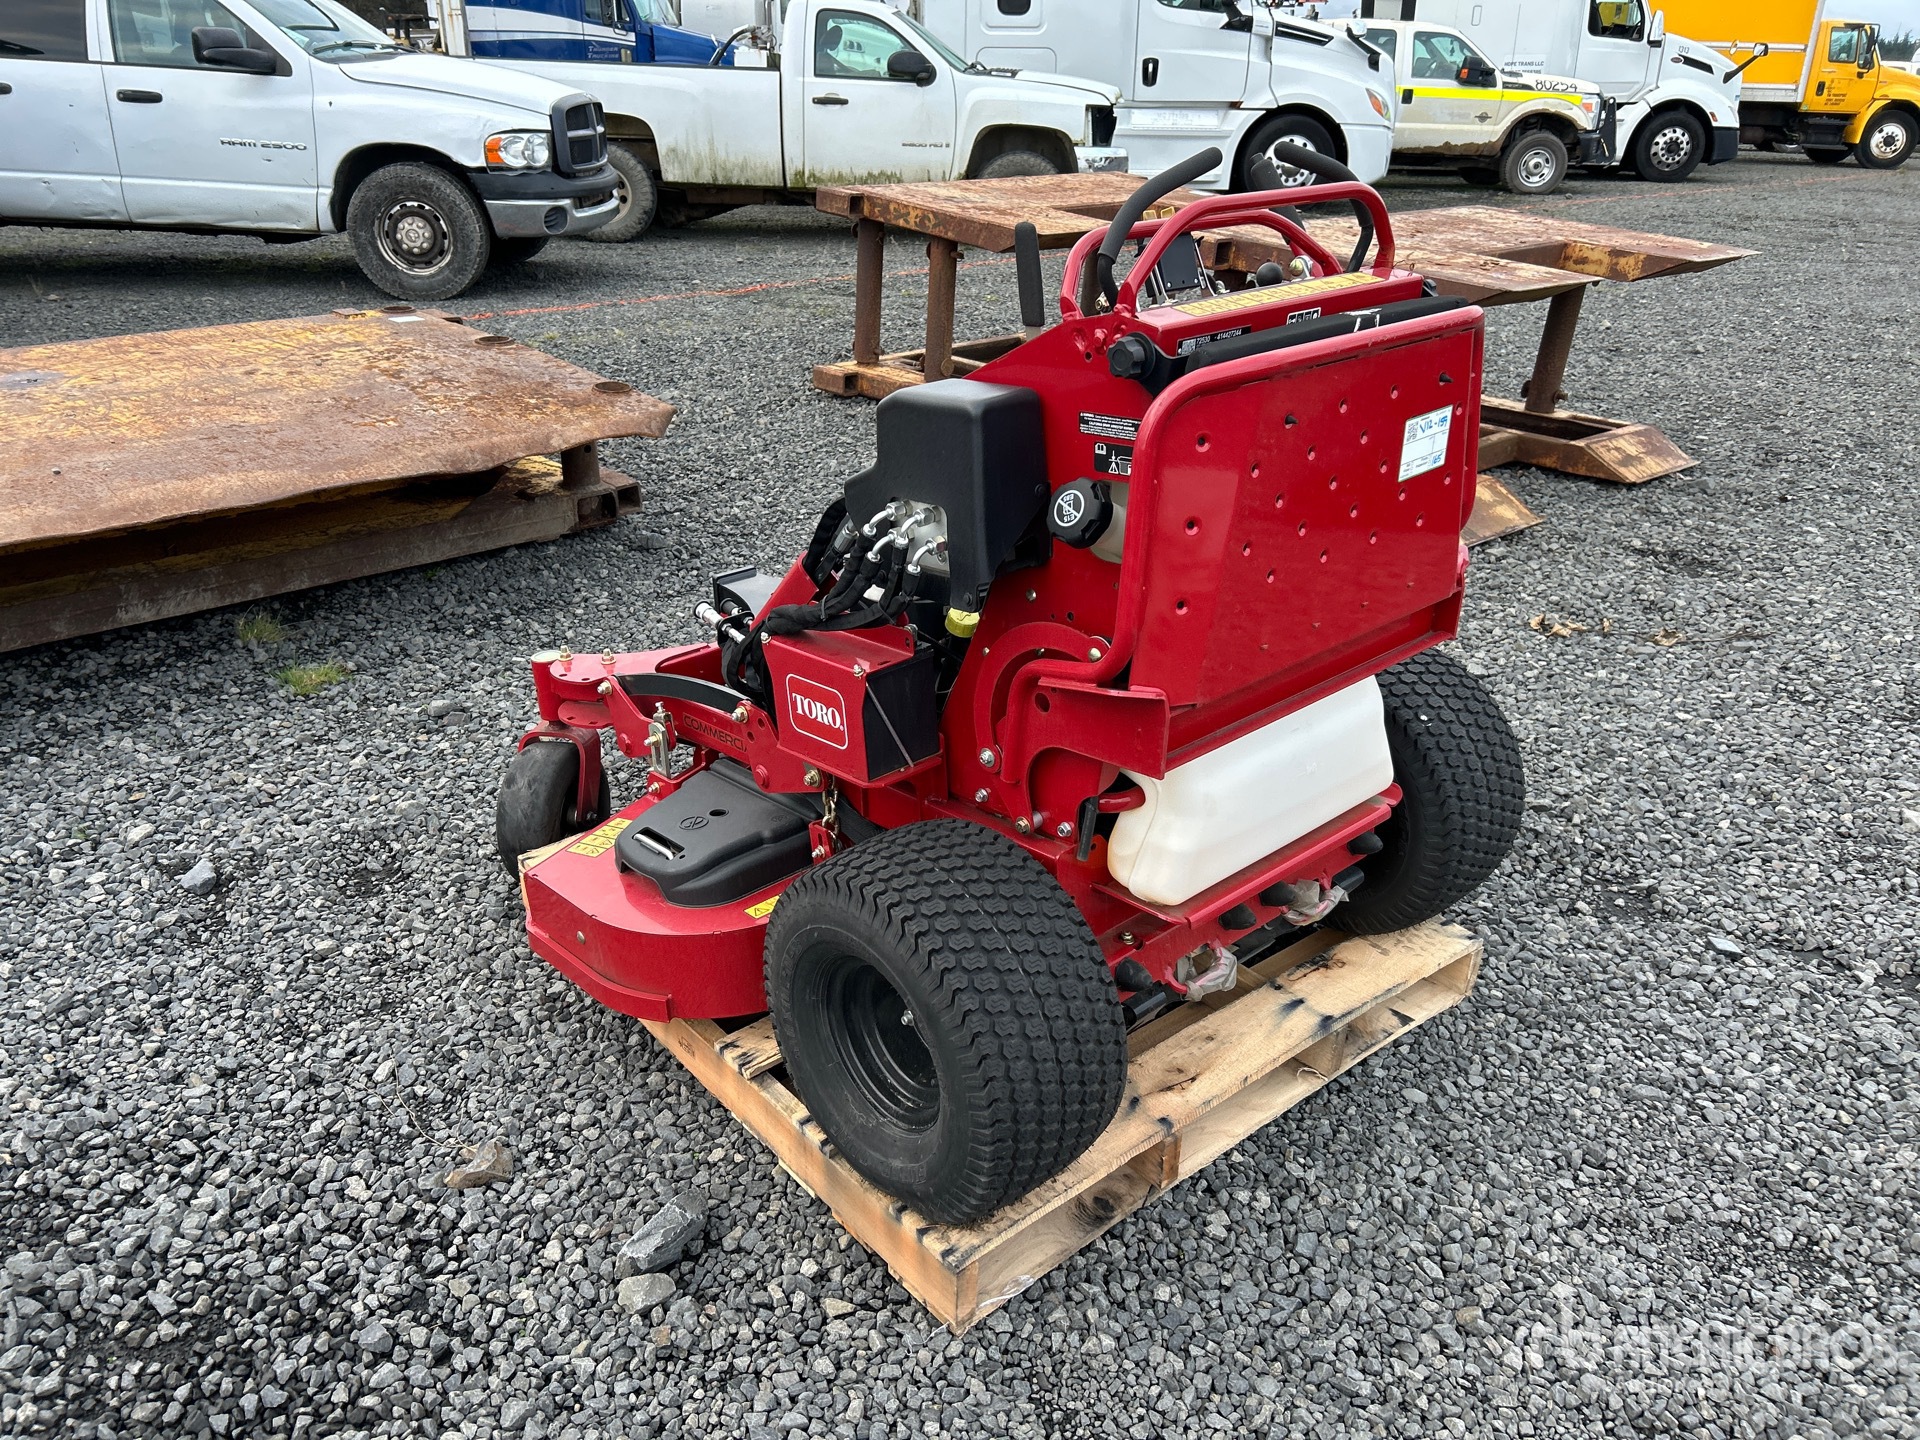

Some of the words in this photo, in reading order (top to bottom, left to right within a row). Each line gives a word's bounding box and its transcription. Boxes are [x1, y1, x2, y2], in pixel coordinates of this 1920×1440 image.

[1535, 79, 1578, 93] 80254
[219, 137, 257, 147] RAM
[259, 140, 307, 151] 2500
[1063, 513, 1075, 523] E15
[792, 692, 842, 730] TORO
